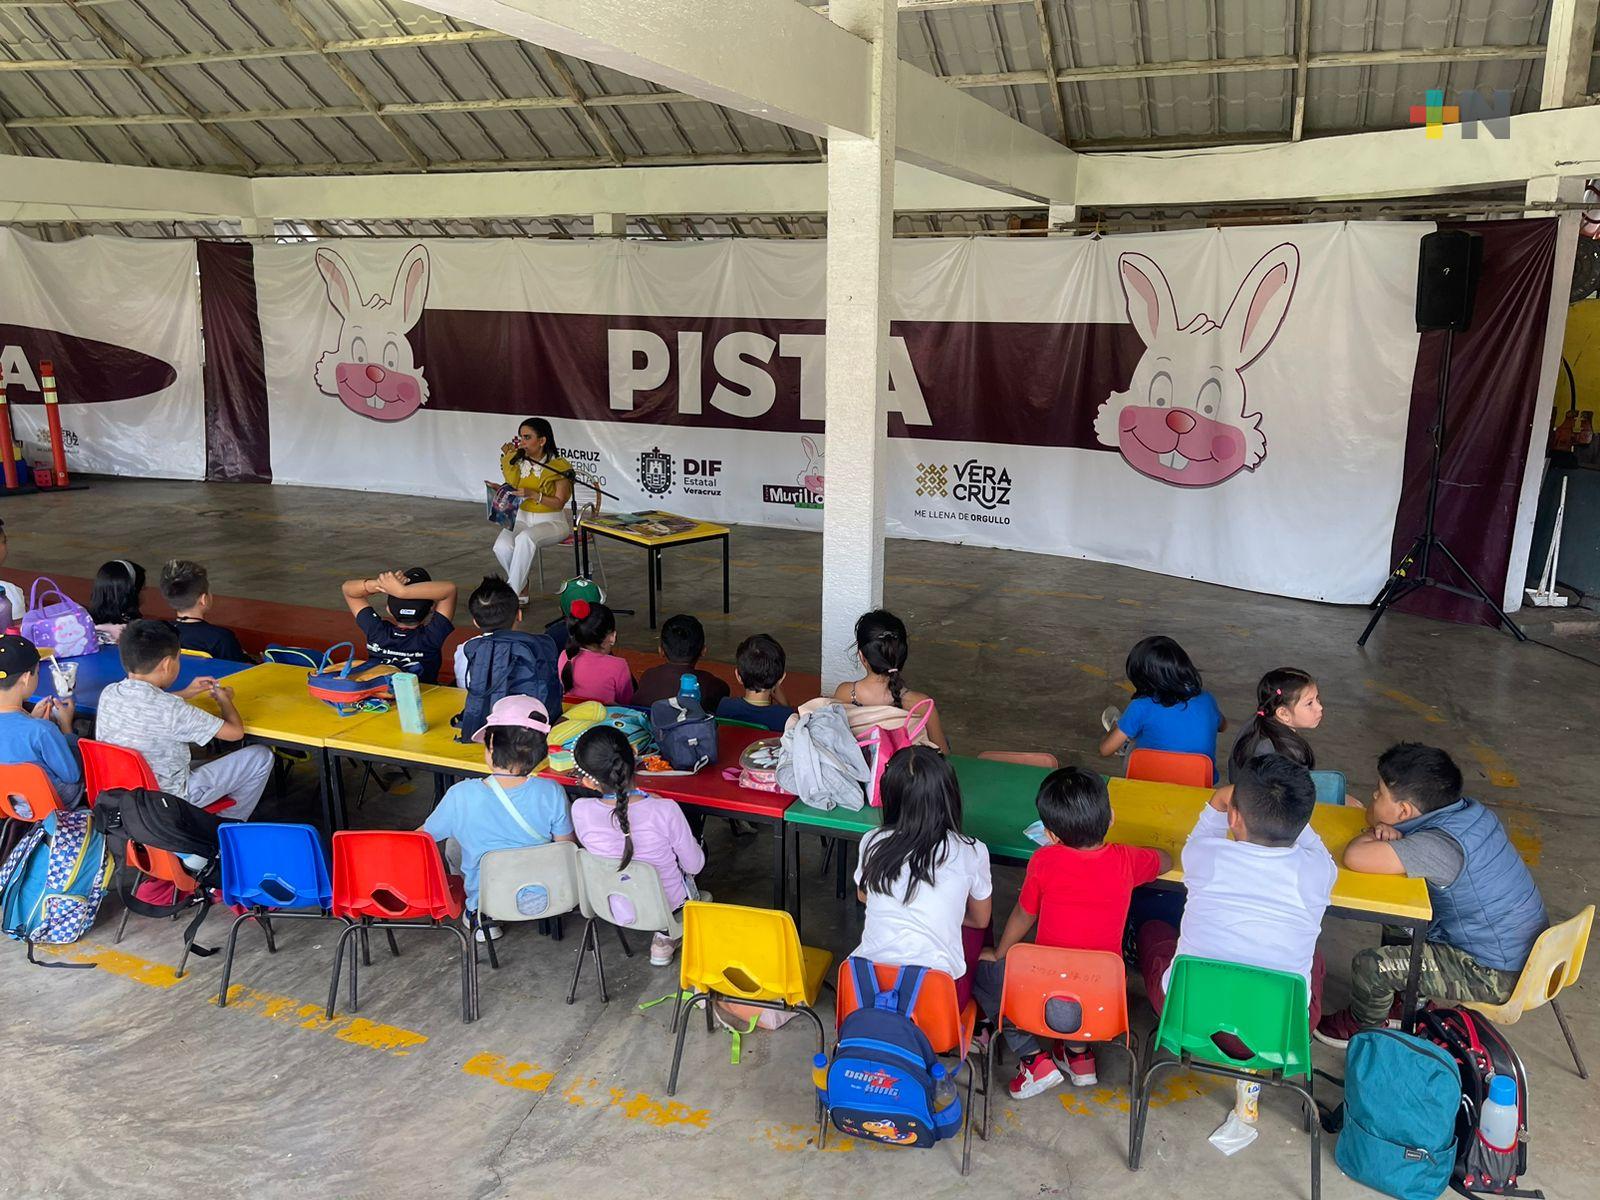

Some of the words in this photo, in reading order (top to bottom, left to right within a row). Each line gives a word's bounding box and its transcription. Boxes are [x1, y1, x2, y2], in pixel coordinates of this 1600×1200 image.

[607, 328, 933, 427] PISTA
[556, 448, 600, 461] ERACRUZ
[570, 461, 597, 473] ERNO
[683, 459, 722, 476] DIF
[953, 459, 1012, 486] VERA
[683, 477, 717, 487] Estatal
[683, 487, 722, 496] Veracruz
[769, 487, 824, 504] Murillo
[953, 483, 1012, 510] CRUZ
[914, 510, 927, 518] ME
[928, 511, 957, 520] LLENA
[958, 512, 970, 521] DE
[970, 514, 1011, 525] ORGULLO
